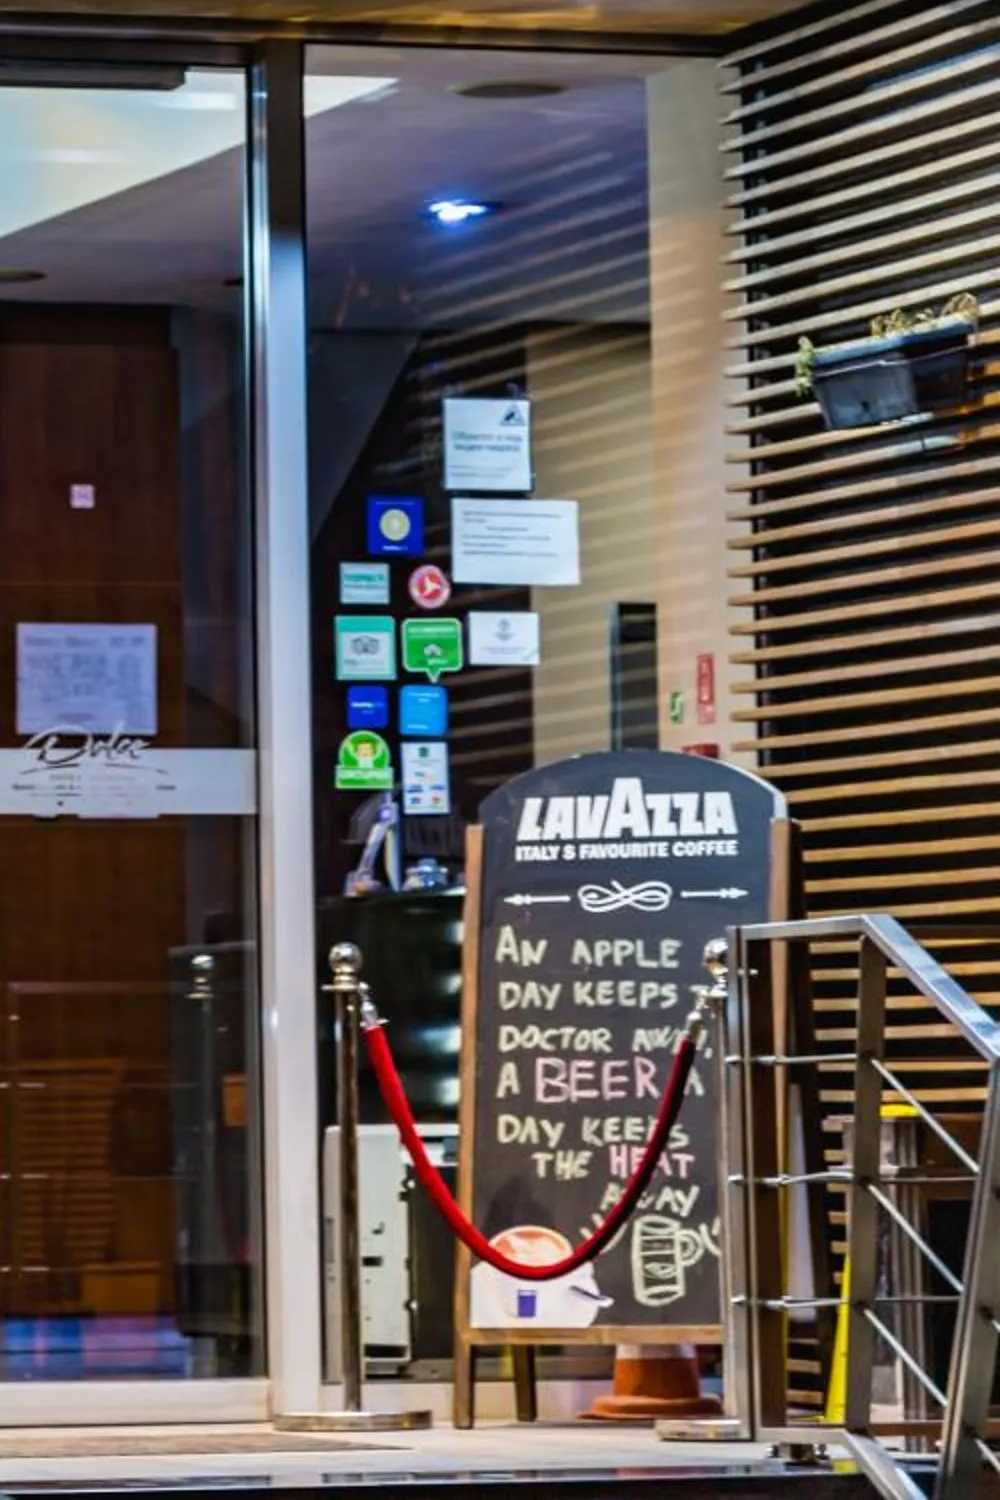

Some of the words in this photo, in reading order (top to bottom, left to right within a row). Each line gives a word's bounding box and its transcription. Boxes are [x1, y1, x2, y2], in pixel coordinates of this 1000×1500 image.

[516, 777, 739, 841] LAVAZZA
[579, 841, 670, 859] FAVOURITE
[672, 840, 739, 857] COFFEE
[495, 924, 548, 966] AN
[570, 938, 683, 968] APPLE
[499, 980, 562, 1011] DAY
[573, 980, 679, 1008] KEEPS
[498, 1024, 613, 1053] DOCTOR
[496, 1062, 520, 1098] A
[535, 1056, 661, 1103] BEER
[497, 1113, 565, 1147] DAY
[581, 1115, 690, 1149] KEES
[531, 1149, 592, 1180] THE
